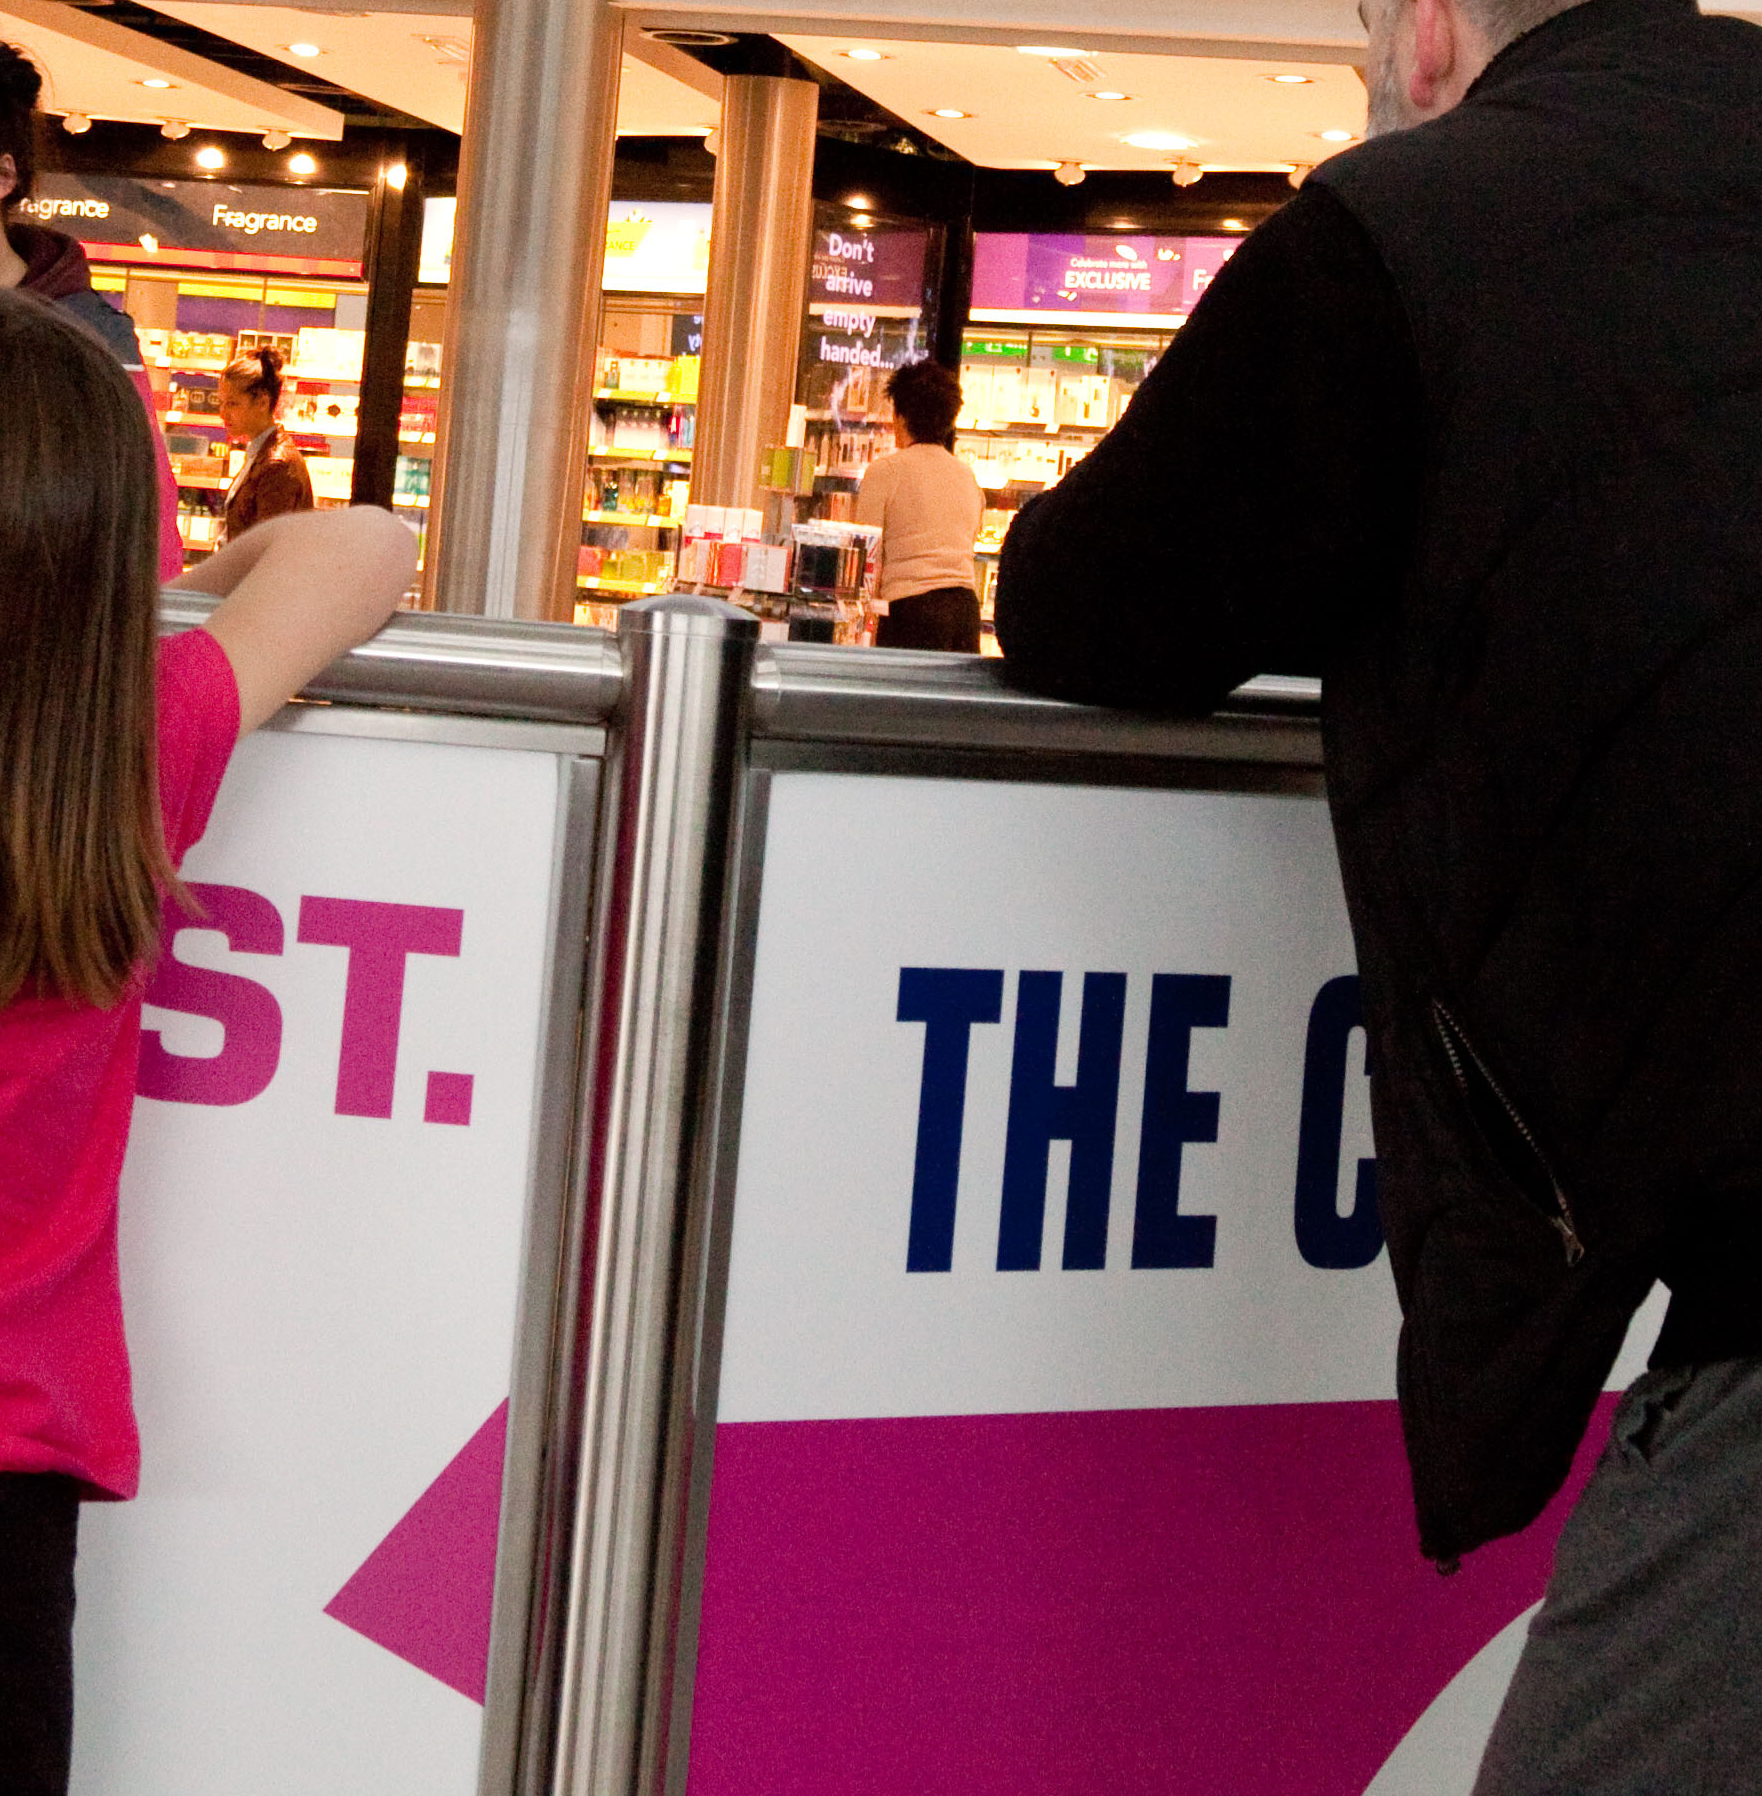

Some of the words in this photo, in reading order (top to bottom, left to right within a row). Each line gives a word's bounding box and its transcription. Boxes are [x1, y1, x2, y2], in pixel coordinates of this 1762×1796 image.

[212, 203, 318, 235] Fragrance
[828, 233, 875, 263] Don't
[825, 271, 874, 297] arrive
[1064, 270, 1151, 291] EXCLUSIVE
[822, 308, 876, 338] empty
[819, 335, 895, 369] handed...
[895, 965, 1233, 1274] THE
